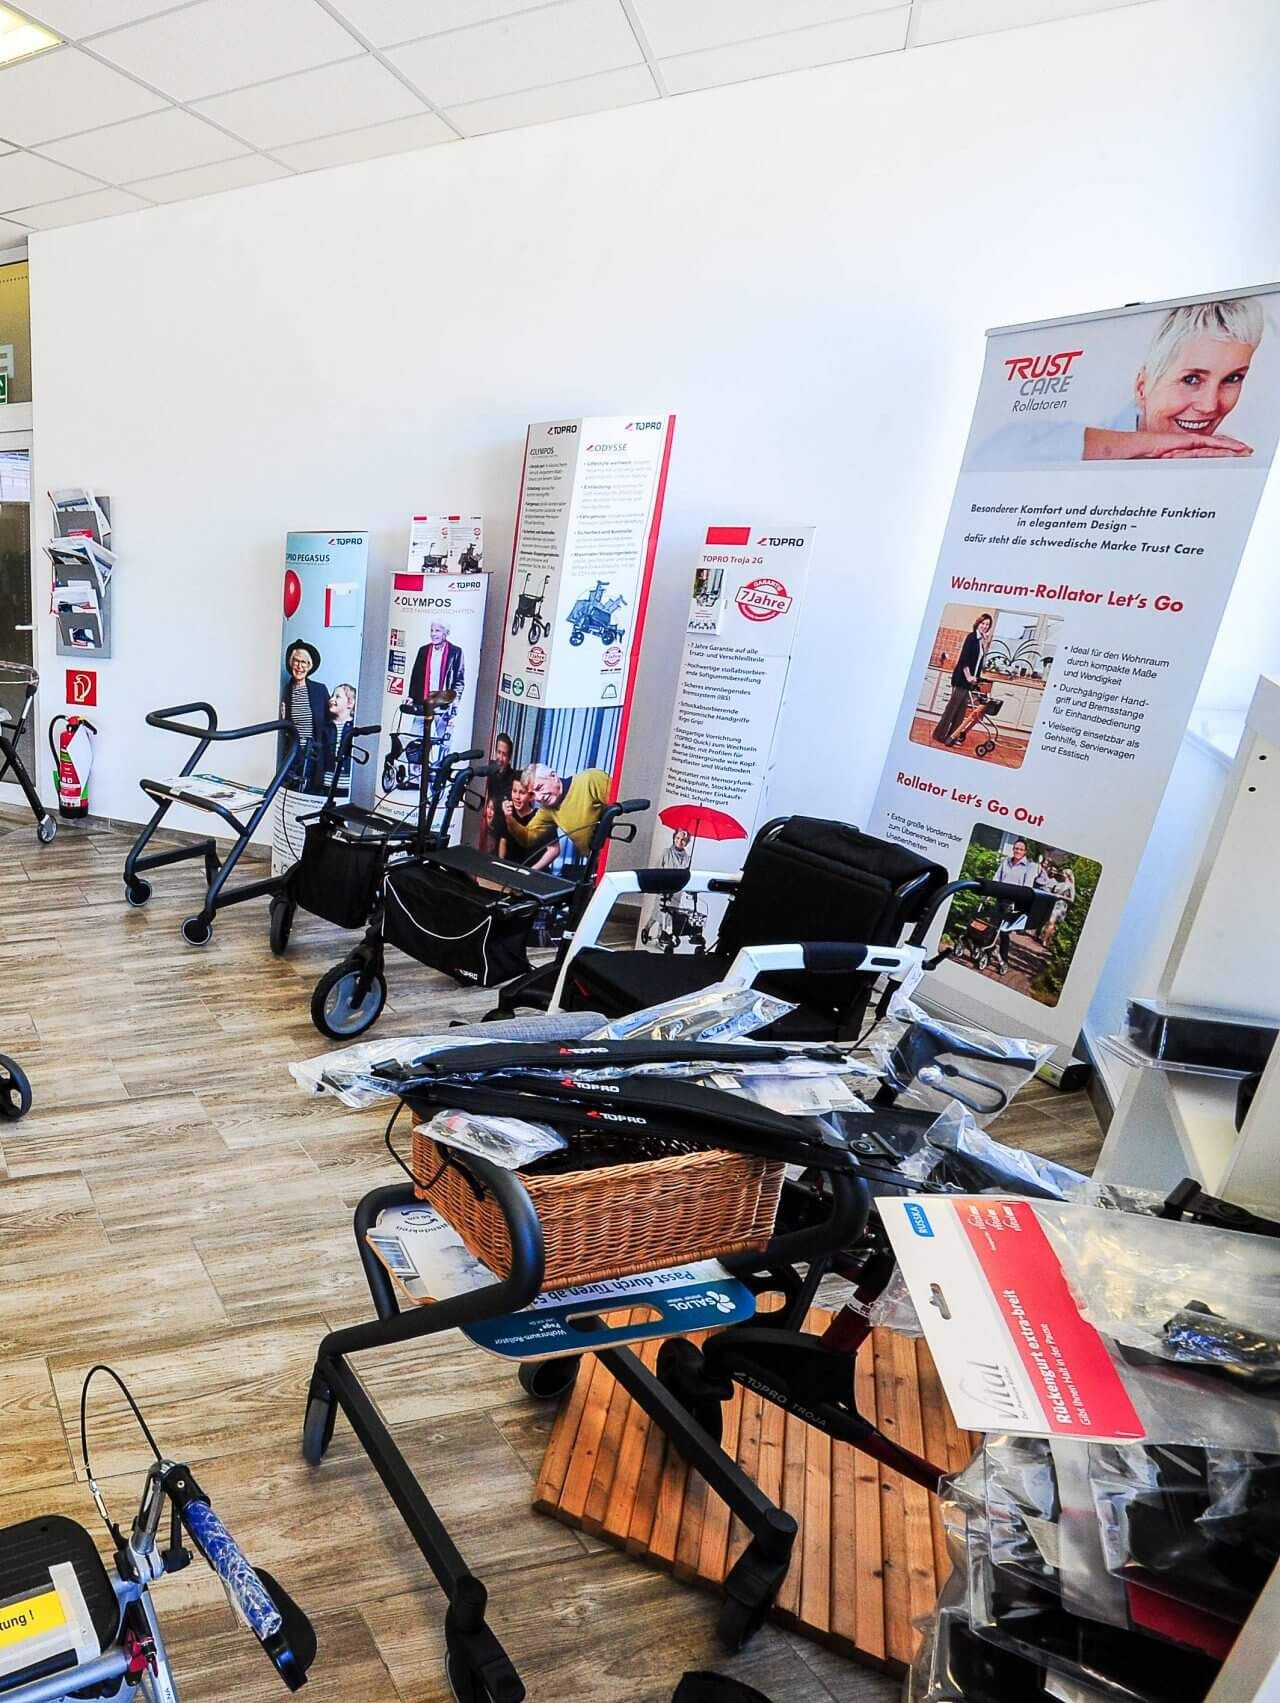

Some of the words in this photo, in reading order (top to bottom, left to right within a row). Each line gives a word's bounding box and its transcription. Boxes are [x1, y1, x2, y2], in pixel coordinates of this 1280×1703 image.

[1005, 350, 1084, 381] TRUST
[1020, 375, 1073, 396] CARE
[1012, 399, 1068, 413] Rollatoren
[554, 425, 577, 435] TOPRO
[635, 422, 661, 431] TOPRO
[970, 504, 1018, 514] Besonderer
[1020, 504, 1062, 515] Komfort
[1065, 505, 1087, 515] und
[1090, 505, 1157, 517] durchdachte
[1160, 507, 1216, 519] Funktion
[1017, 517, 1026, 527] in
[1029, 518, 1087, 530] elegantem
[1090, 520, 1127, 533] Design
[769, 537, 805, 547] TOPRO
[963, 533, 987, 543] dafür
[988, 535, 1010, 545] steht
[1012, 536, 1027, 545] die
[1029, 537, 1098, 549] schwedische
[1100, 540, 1137, 551] Marke
[1141, 542, 1170, 553] Trust
[1174, 544, 1204, 555] Care
[297, 554, 330, 562] PEGASUS
[703, 555, 729, 563] TOPRO
[730, 556, 750, 565] Troja
[401, 597, 452, 608] OLYMPOS
[741, 591, 750, 601] 7
[748, 593, 786, 609] Jahre
[951, 576, 1103, 604] Wohnraum-Rollator
[1154, 595, 1184, 612] Go
[1070, 646, 1089, 655] Ideal
[1091, 648, 1102, 657] für
[1103, 650, 1119, 660] den
[1121, 653, 1169, 667] Wohnraum
[1067, 657, 1089, 667] durch
[1090, 661, 1130, 675] kompakte
[1132, 668, 1157, 679] Maße
[1064, 669, 1078, 678] und
[1080, 671, 1122, 686] Wendigkeit
[1059, 683, 1119, 702] Durchgängiger
[1121, 696, 1150, 707] Hand-
[1056, 696, 1071, 705] griff
[1072, 699, 1087, 708] und
[1088, 701, 1145, 720] Bremsstange
[1053, 706, 1063, 715] für
[1065, 709, 1141, 733] Einhandbedienung
[1048, 721, 1081, 736] Vielseitig
[1082, 729, 1125, 745] einsetzbar
[1126, 739, 1140, 749] als
[1041, 744, 1056, 753] und
[1057, 747, 1089, 761] Esstisch
[1080, 740, 1135, 760] Servierwagen
[896, 771, 948, 797] Rollator
[987, 799, 1009, 816] Go
[1014, 807, 1045, 827] Out
[937, 840, 949, 848] von
[573, 1081, 620, 1093] TOPRO
[600, 1112, 647, 1124] TOPRO
[910, 1205, 929, 1234] RUSSKA
[614, 1276, 653, 1291] durch
[658, 1271, 695, 1283] Passt
[548, 1287, 569, 1301] ab
[570, 1282, 612, 1297] Türen
[1003, 1289, 1040, 1350] extra-breit
[1039, 1323, 1057, 1345] Pause
[1050, 1345, 1064, 1358] der
[1057, 1358, 1068, 1366] in
[1060, 1367, 1076, 1384] Halt
[1030, 1352, 1072, 1424] Rückengurt
[1067, 1384, 1084, 1407] Ihnen
[747, 1376, 788, 1404] TOPRO
[792, 1402, 827, 1426] TROJA
[1074, 1408, 1092, 1426] Gibt
[29, 1609, 35, 1620] !
